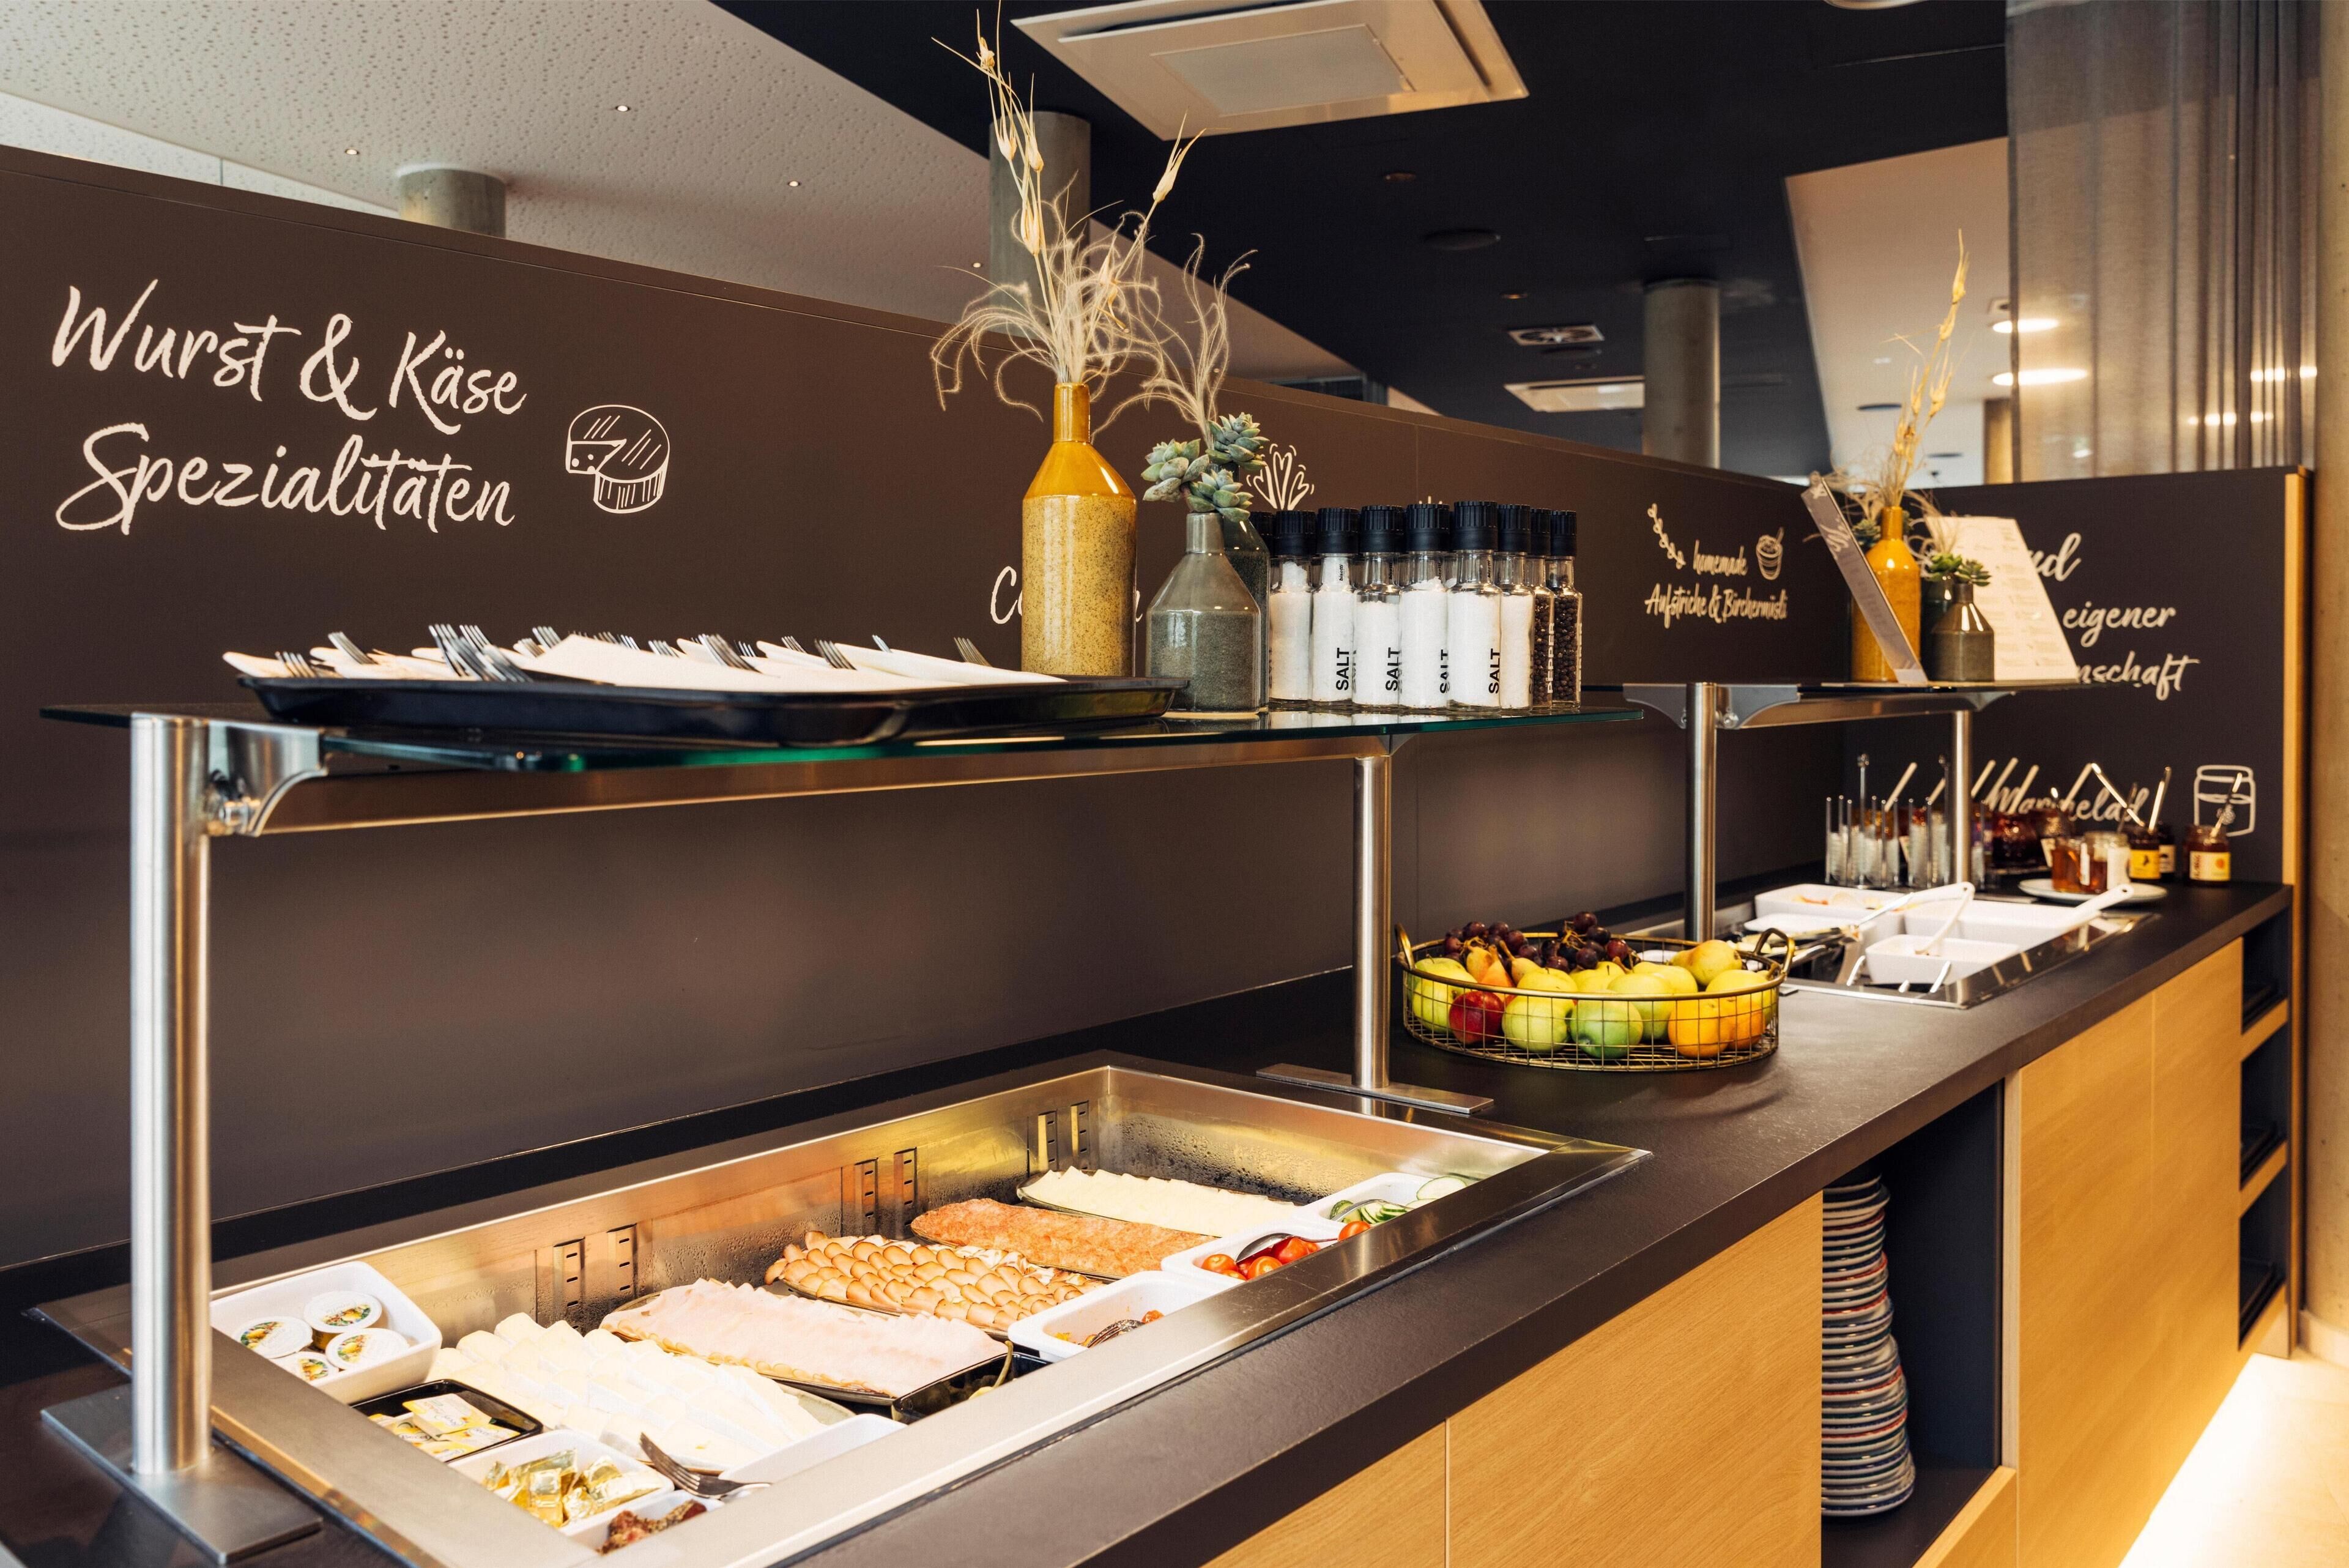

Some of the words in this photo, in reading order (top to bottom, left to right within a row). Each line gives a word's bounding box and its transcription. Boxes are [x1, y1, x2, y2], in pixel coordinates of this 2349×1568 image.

[52, 279, 302, 401] Wurst
[299, 314, 377, 421] &
[389, 330, 527, 435] Käse
[56, 423, 515, 535] Spezialitäten
[1693, 540, 1748, 576] homemade
[1644, 583, 1707, 629] Aufstriche
[1708, 584, 1723, 623] &
[2062, 601, 2176, 647] eigener
[1335, 647, 1349, 691] SALT
[1385, 647, 1400, 691] SALT
[1488, 648, 1501, 694] SALT
[2077, 650, 2200, 700] nschaft
